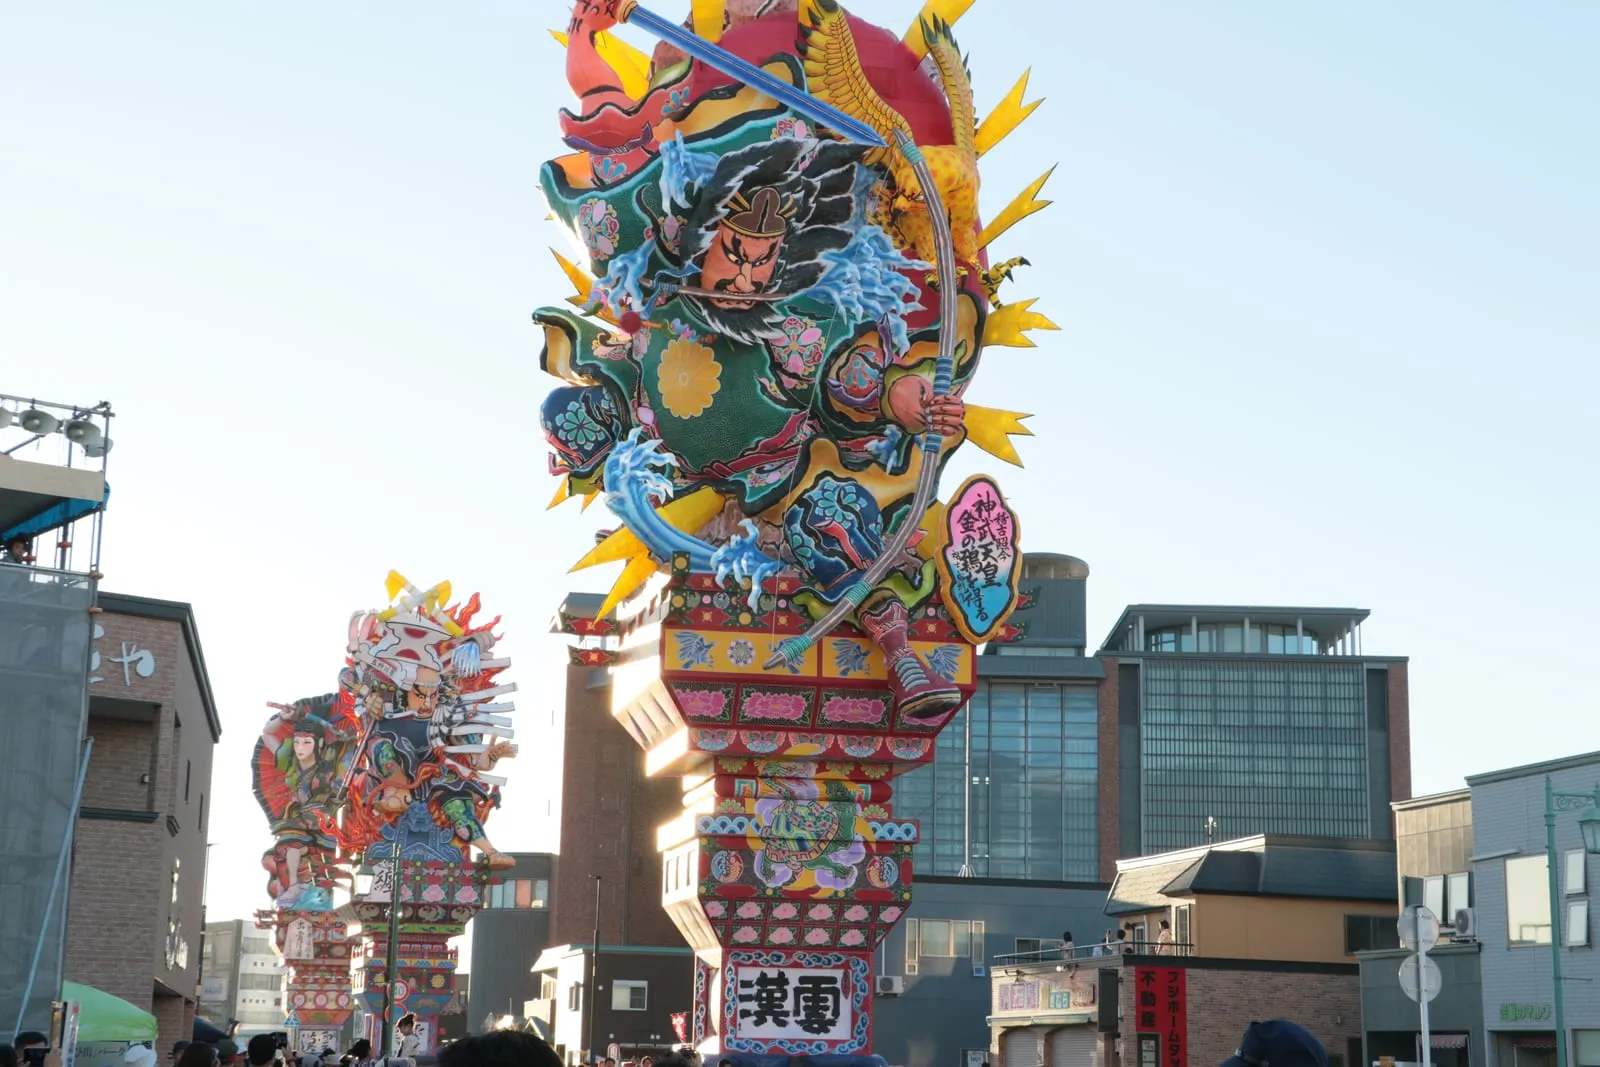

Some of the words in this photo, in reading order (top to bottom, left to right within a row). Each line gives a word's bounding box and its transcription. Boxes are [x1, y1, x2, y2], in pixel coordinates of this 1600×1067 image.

[973, 491, 1002, 588] 神武天皇
[1140, 970, 1156, 1028] 不動産
